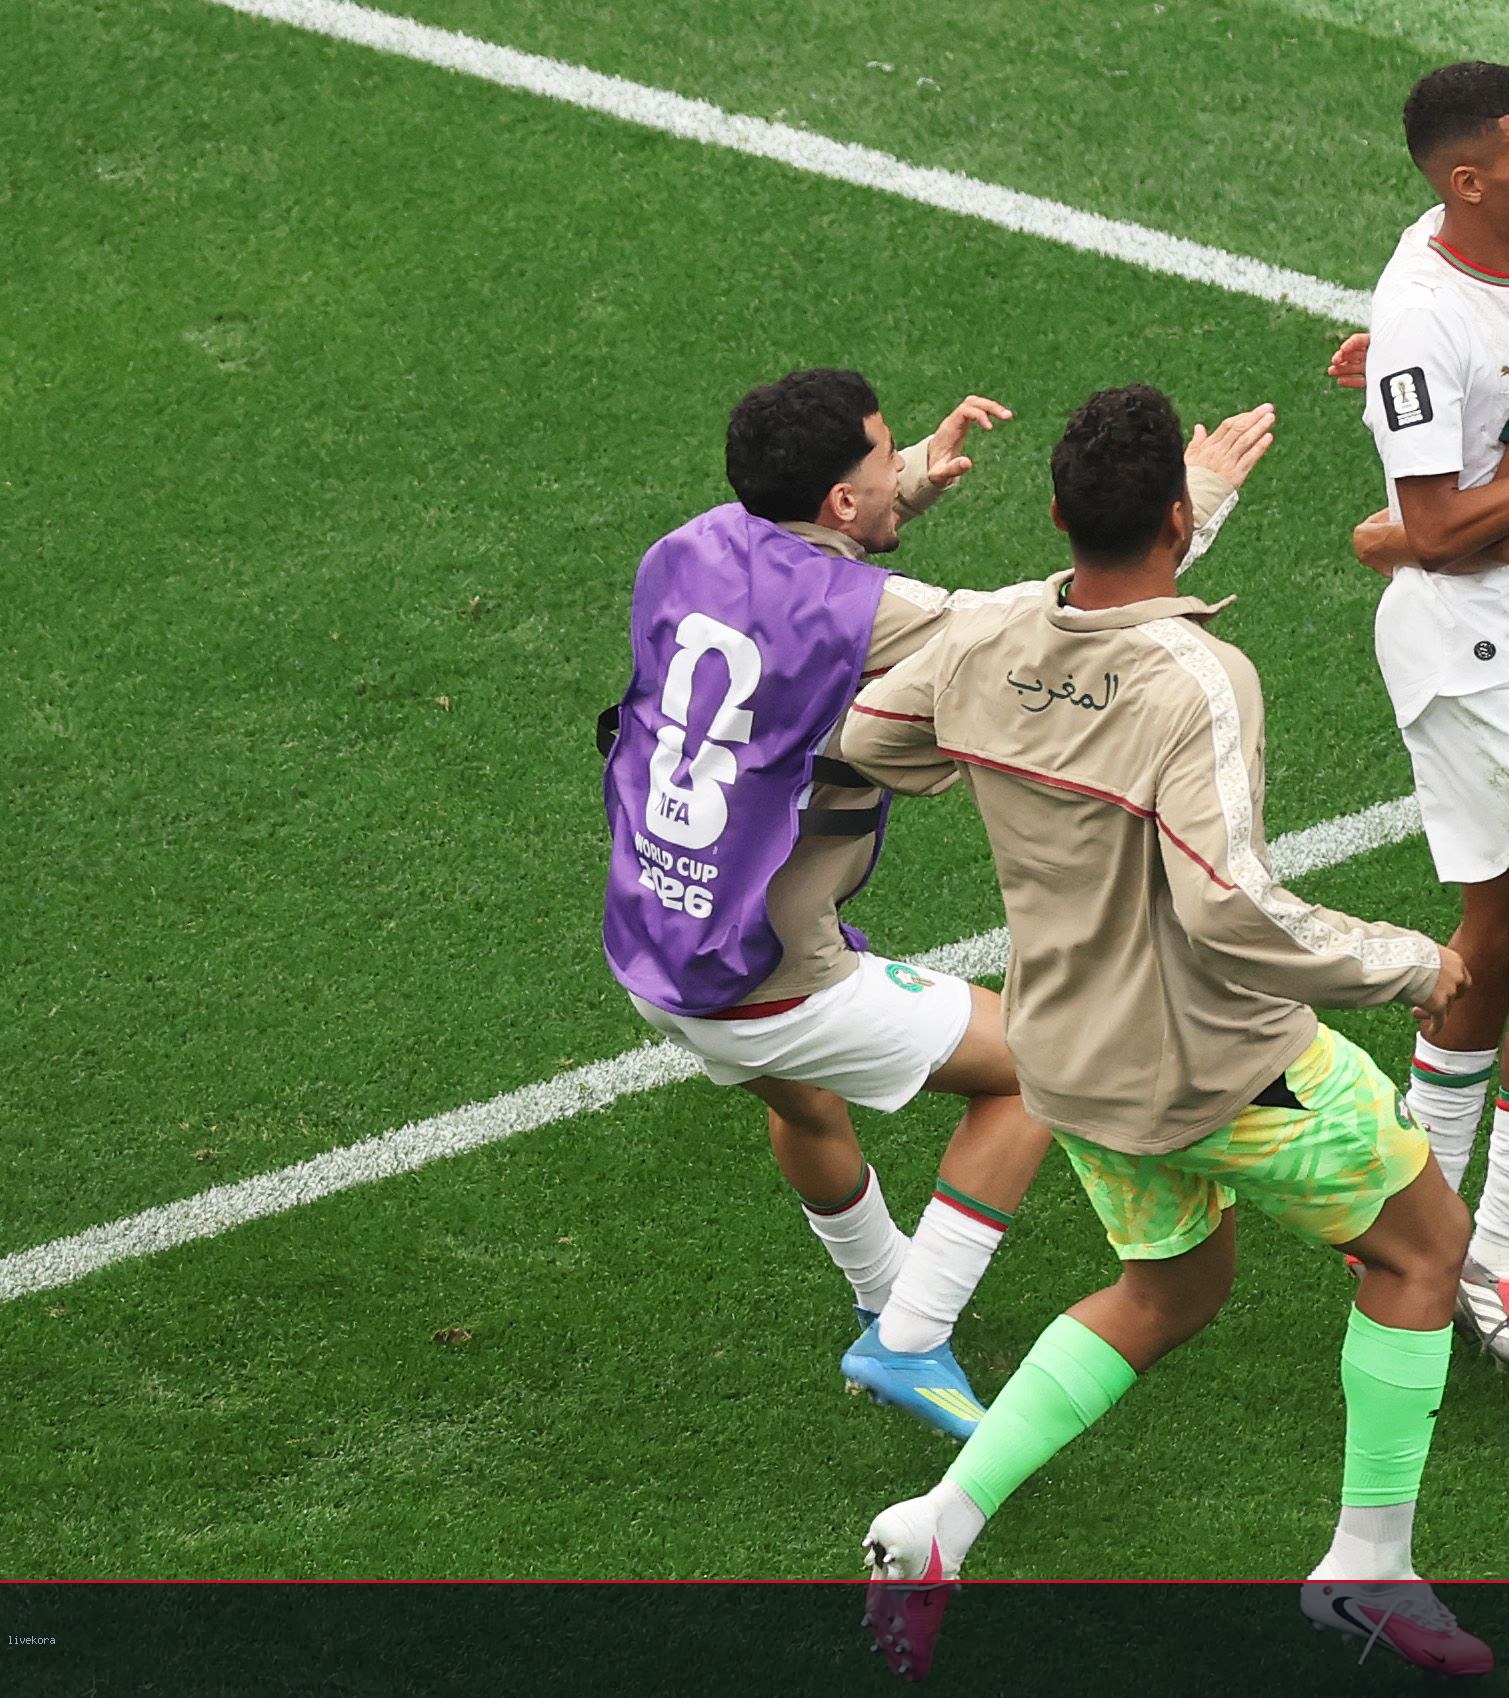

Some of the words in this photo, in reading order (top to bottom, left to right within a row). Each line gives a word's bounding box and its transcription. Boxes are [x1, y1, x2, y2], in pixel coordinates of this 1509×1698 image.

[1007, 670, 1119, 713] المغرب
[655, 792, 690, 826] IFA
[635, 831, 674, 871] WORLD
[677, 856, 719, 883] CUP
[638, 857, 714, 919] 2026
